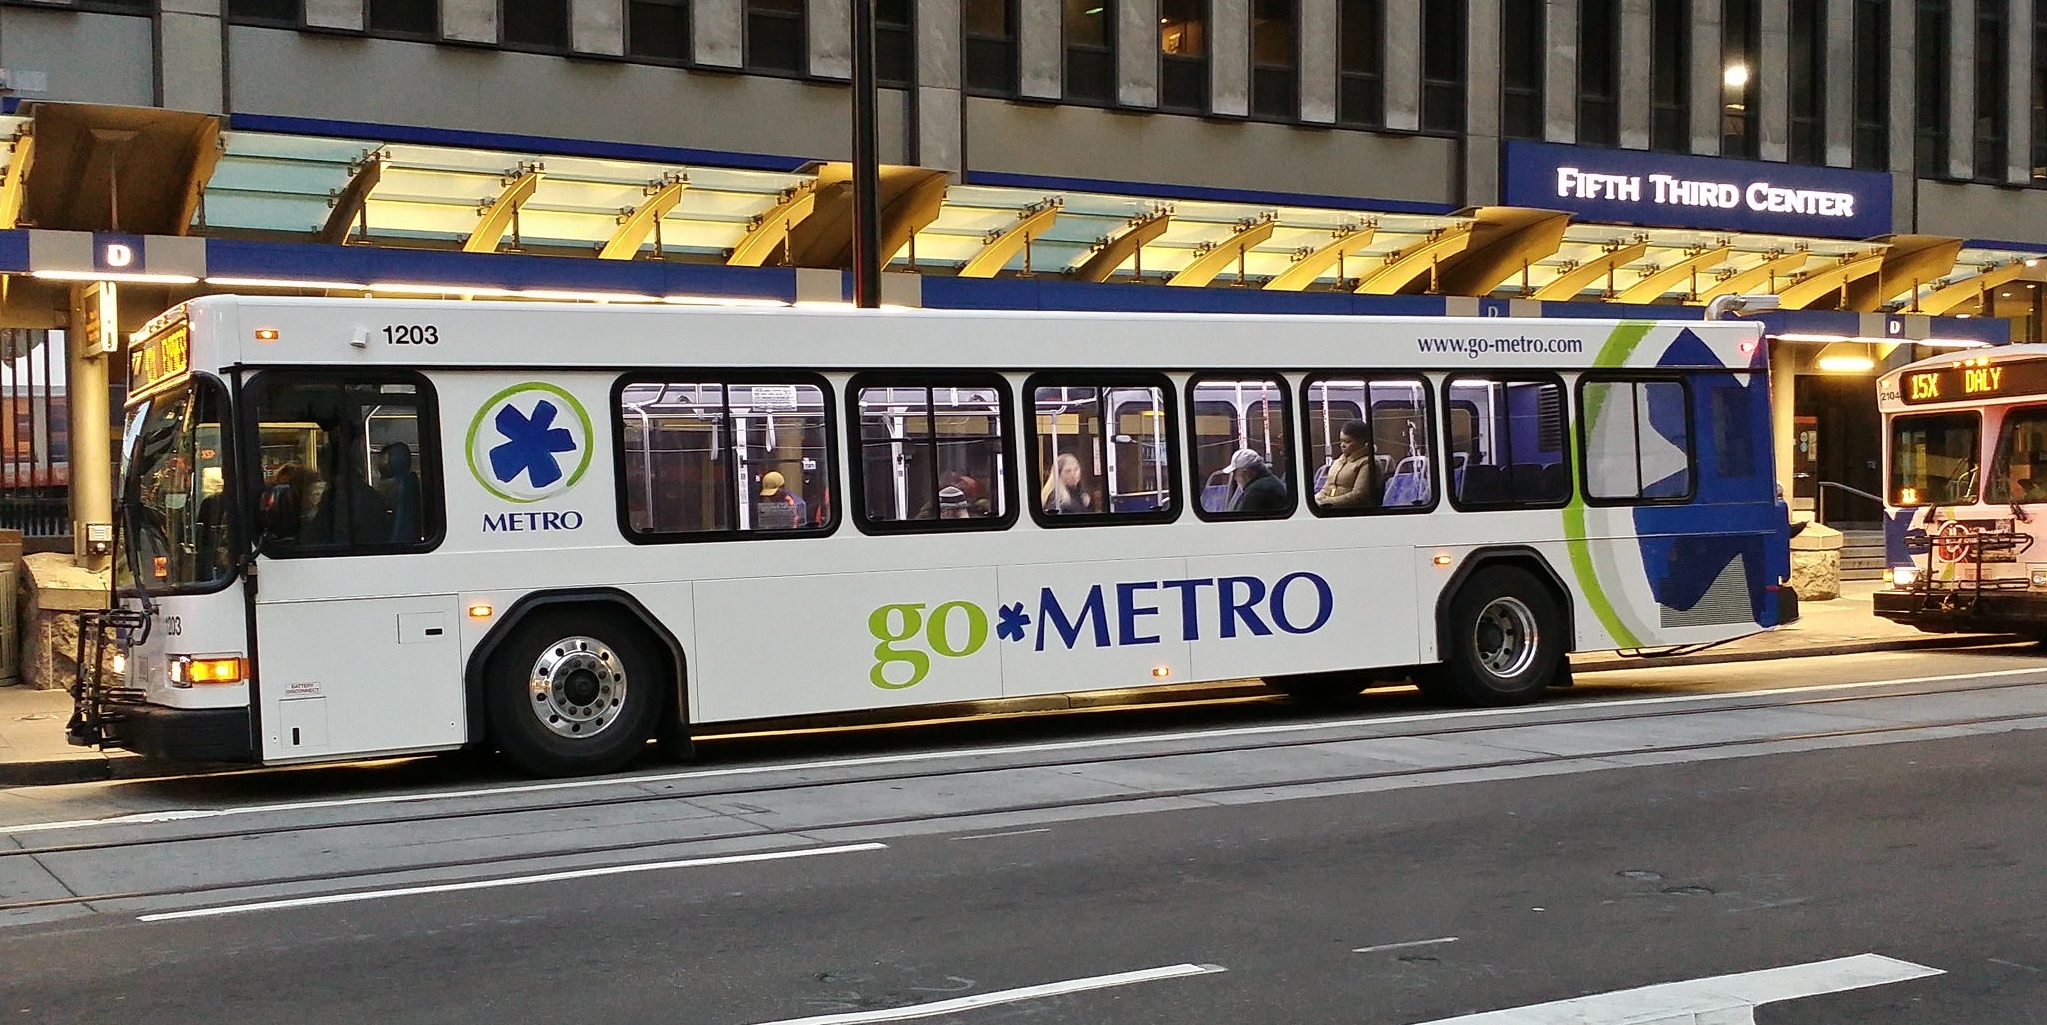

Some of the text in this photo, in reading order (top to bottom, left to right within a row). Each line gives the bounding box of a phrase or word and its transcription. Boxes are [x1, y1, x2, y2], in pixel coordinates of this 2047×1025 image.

[1557, 168, 1854, 217] FIFTH THIRD CENTER
[107, 244, 131, 266] D
[1487, 306, 1499, 317] D
[382, 325, 439, 345] 1203
[1889, 320, 1900, 334] D
[1417, 335, 1583, 359] www.go-metro.com
[1911, 367, 2002, 399] 15X DALY
[482, 511, 583, 532] METRO
[1034, 571, 1334, 652] METRO
